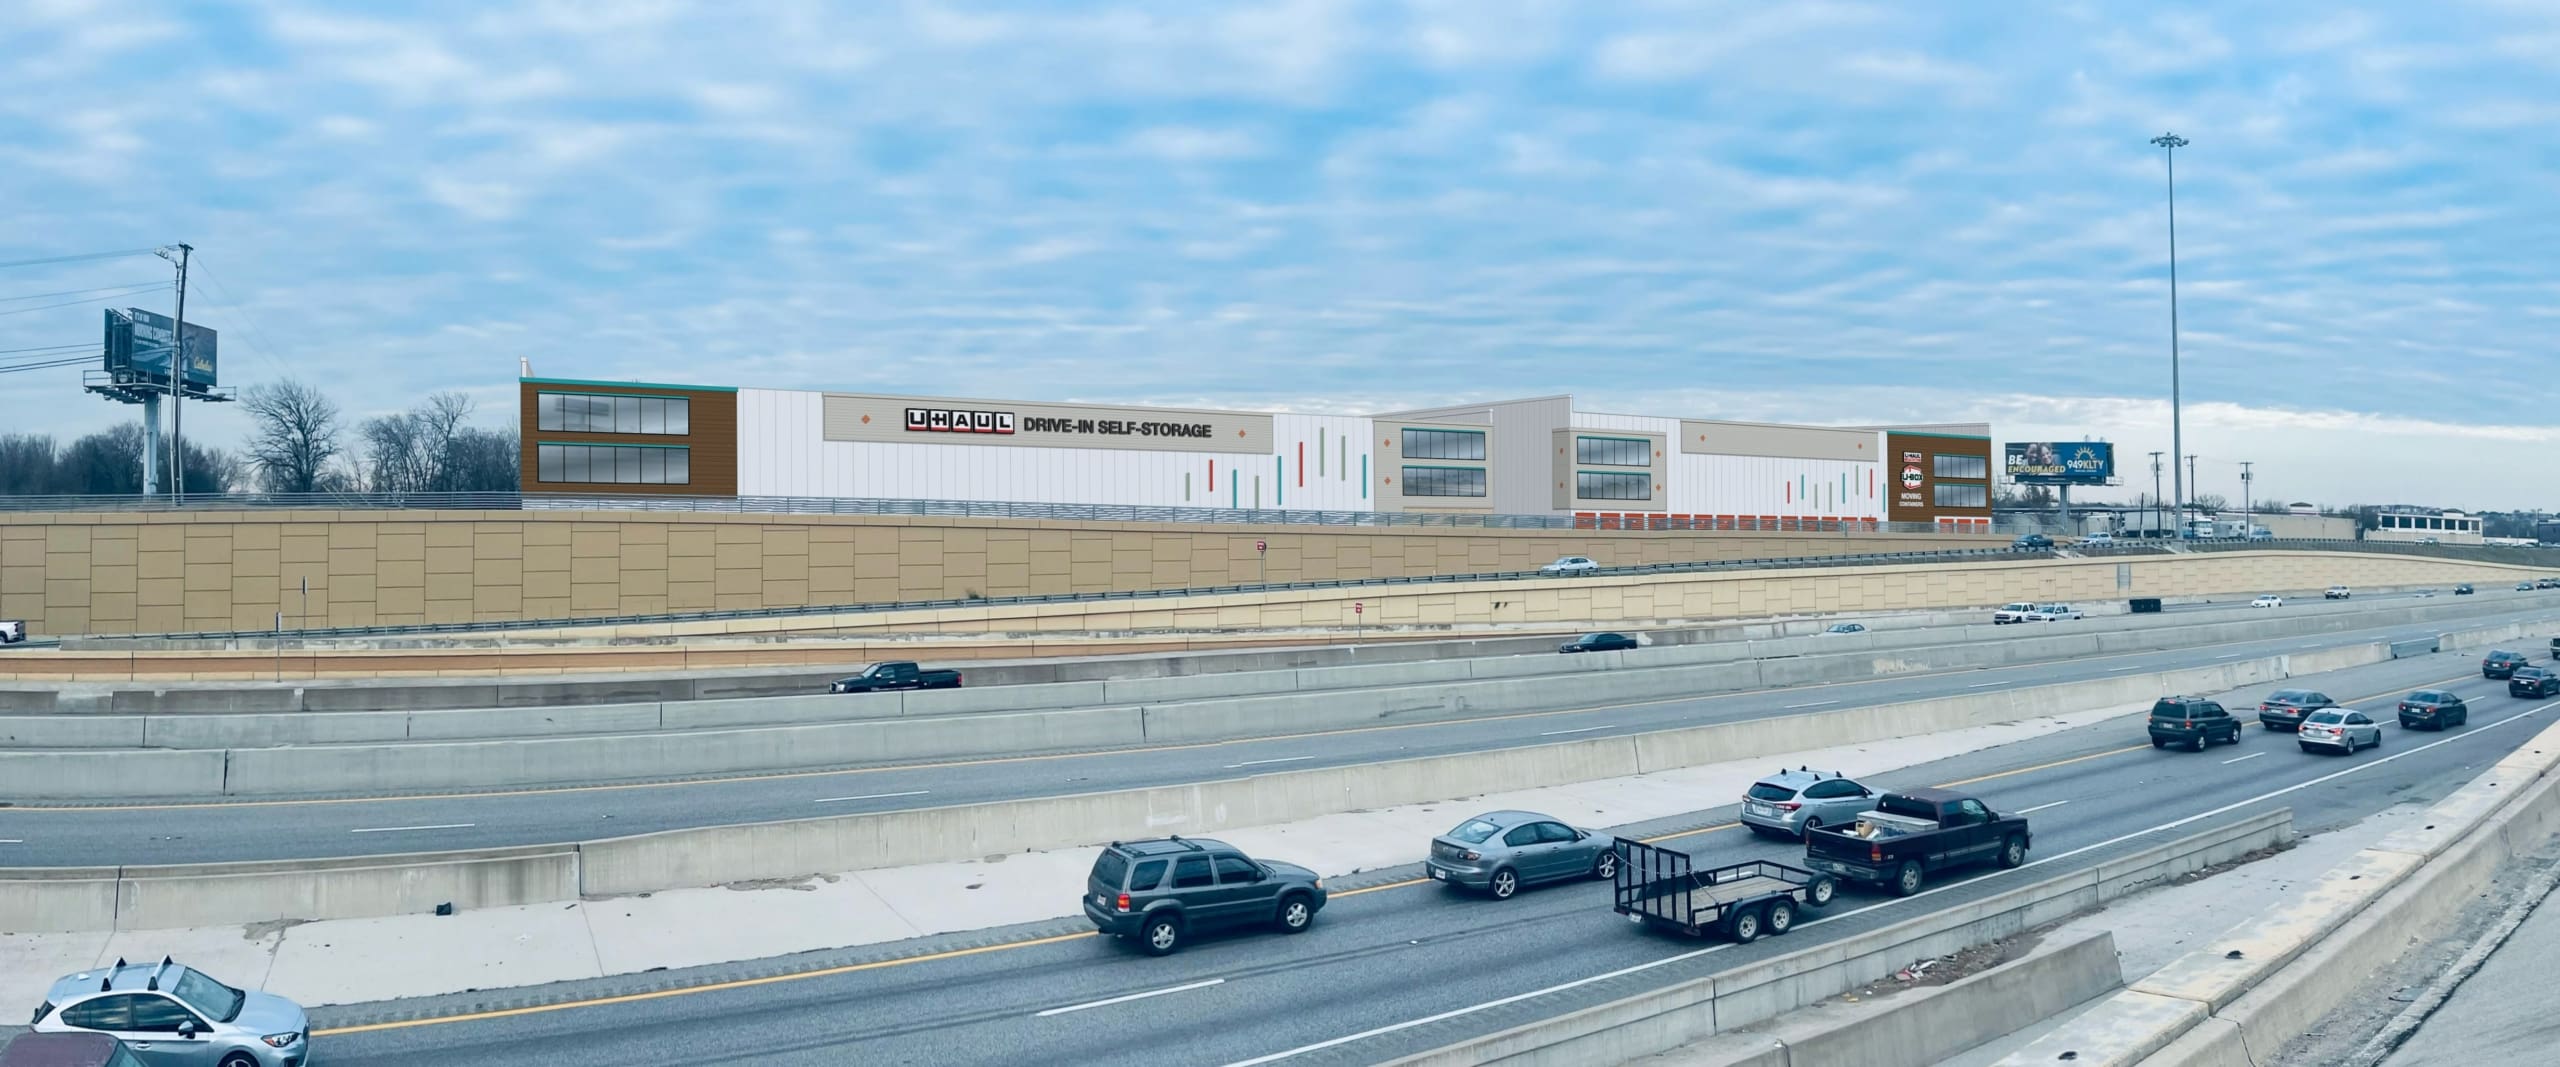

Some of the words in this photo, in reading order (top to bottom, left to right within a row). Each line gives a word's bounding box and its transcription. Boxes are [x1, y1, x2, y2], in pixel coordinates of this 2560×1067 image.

[1024, 416, 1093, 433] DRIVE-IN
[1098, 420, 1213, 438] SELF-STORAGE
[2008, 454, 2024, 465] BE
[2008, 465, 2066, 473] ENCOURAGED
